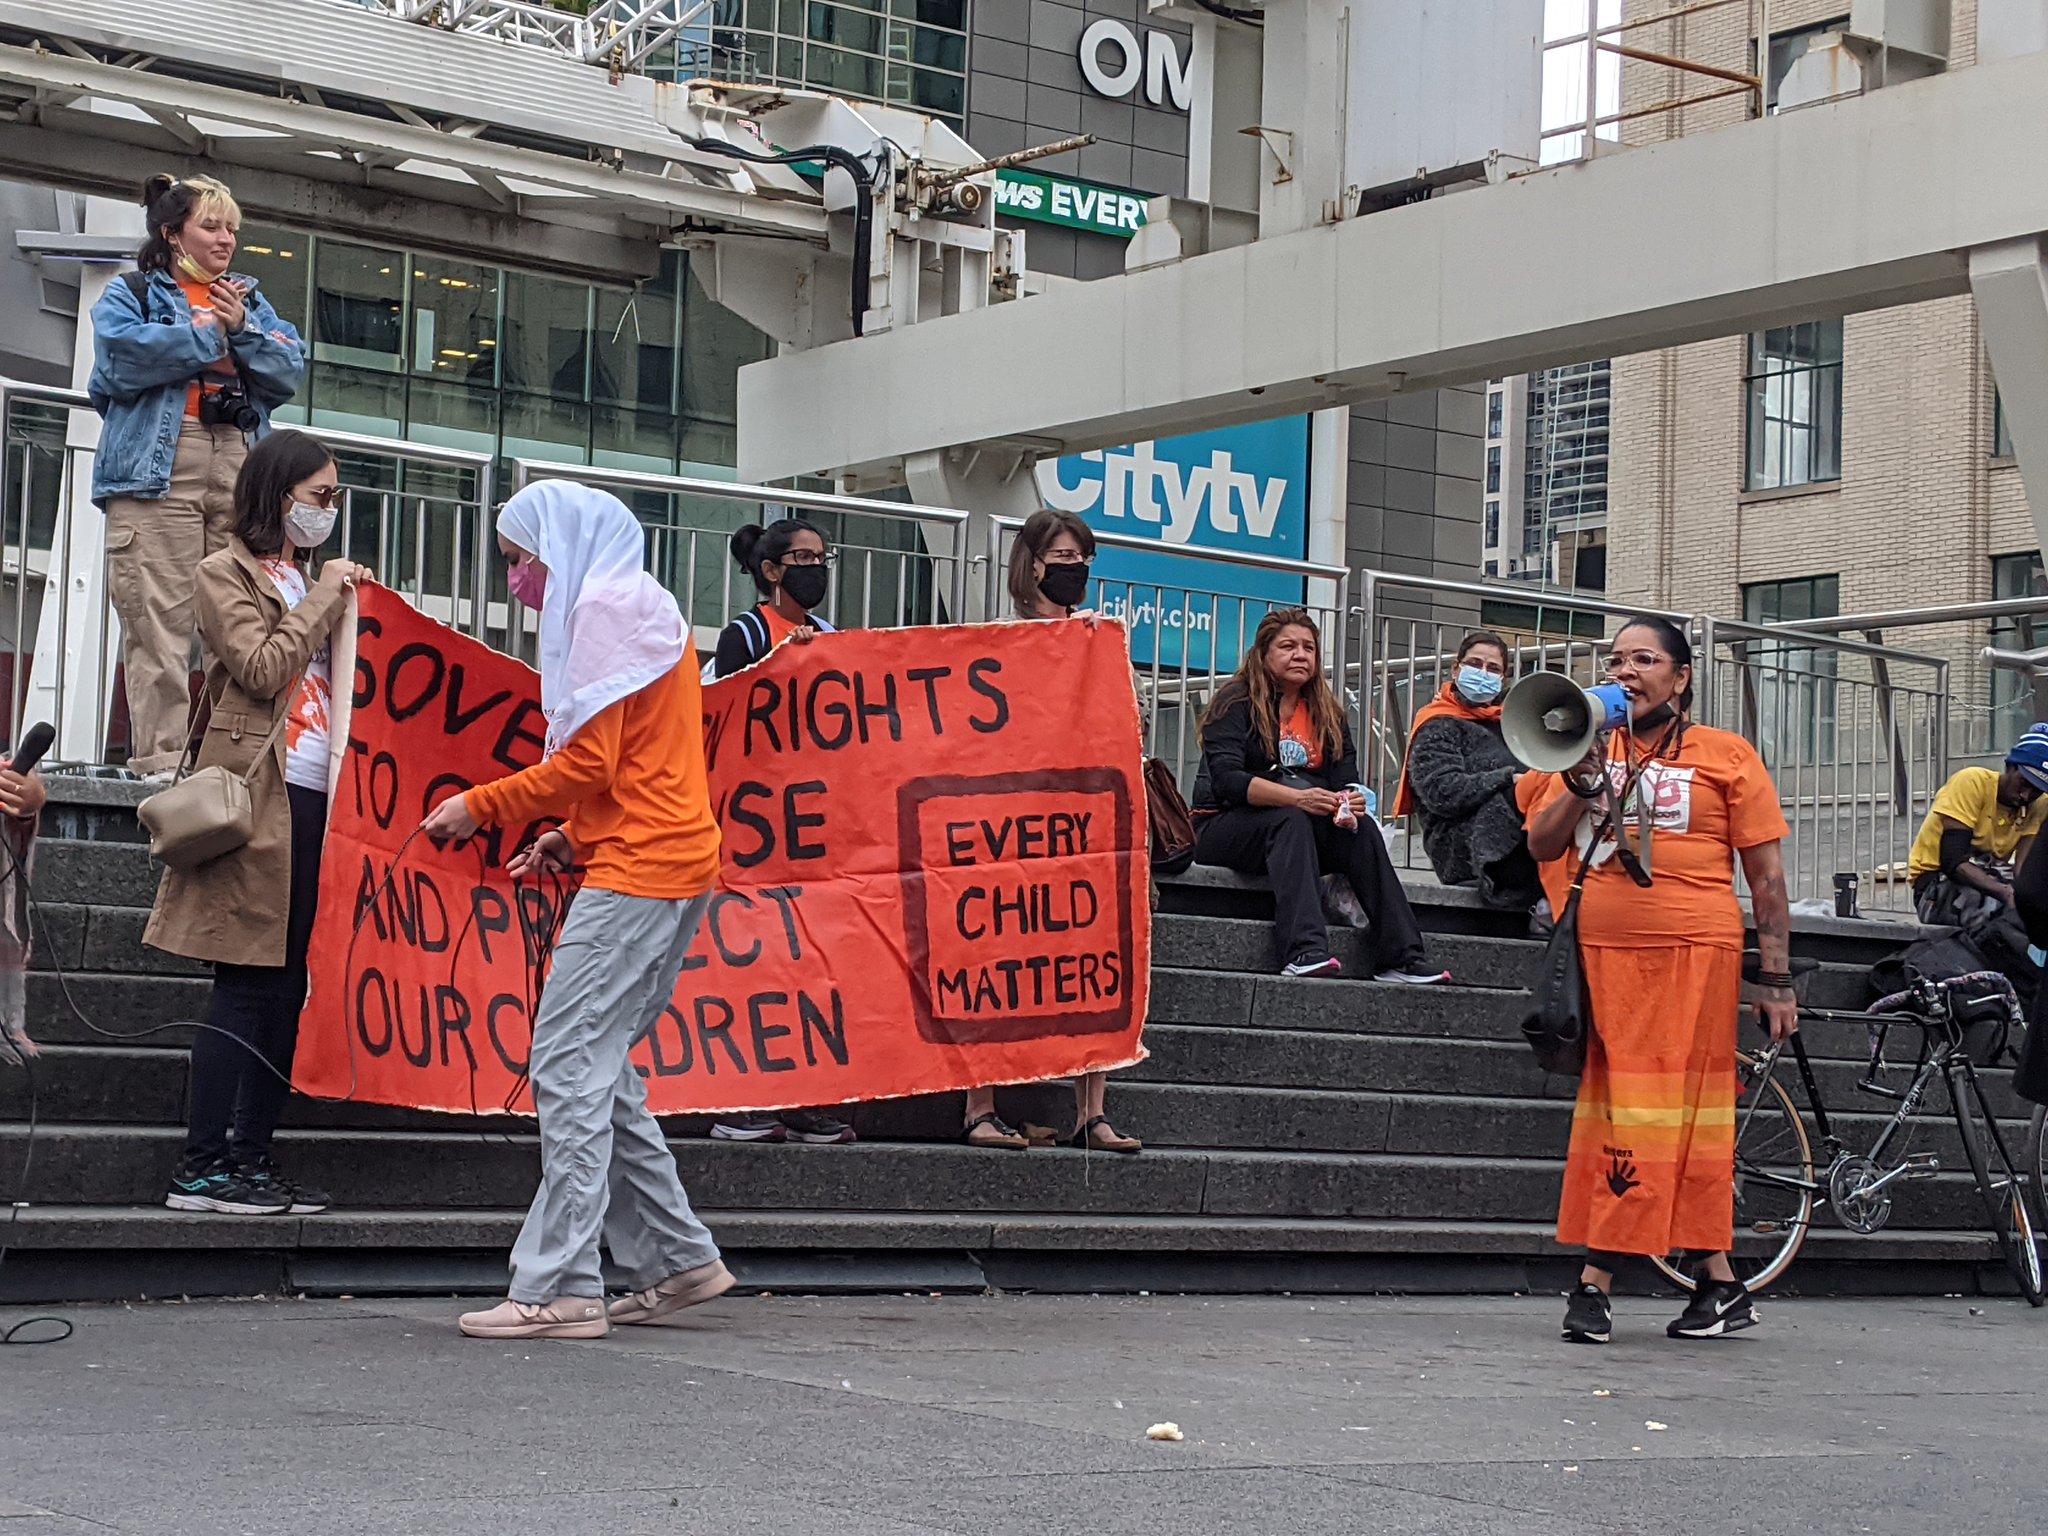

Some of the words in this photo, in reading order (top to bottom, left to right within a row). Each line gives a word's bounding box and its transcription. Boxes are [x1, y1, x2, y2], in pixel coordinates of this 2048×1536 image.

[1035, 440, 1287, 543] Citytv
[744, 657, 1009, 755] RIGHTS
[347, 735, 398, 830] TO
[946, 811, 1093, 867] EVERY
[353, 855, 449, 953] AND
[956, 880, 1098, 940] CHILD
[356, 967, 478, 1071] OUR
[936, 950, 1122, 1014] MATTERS
